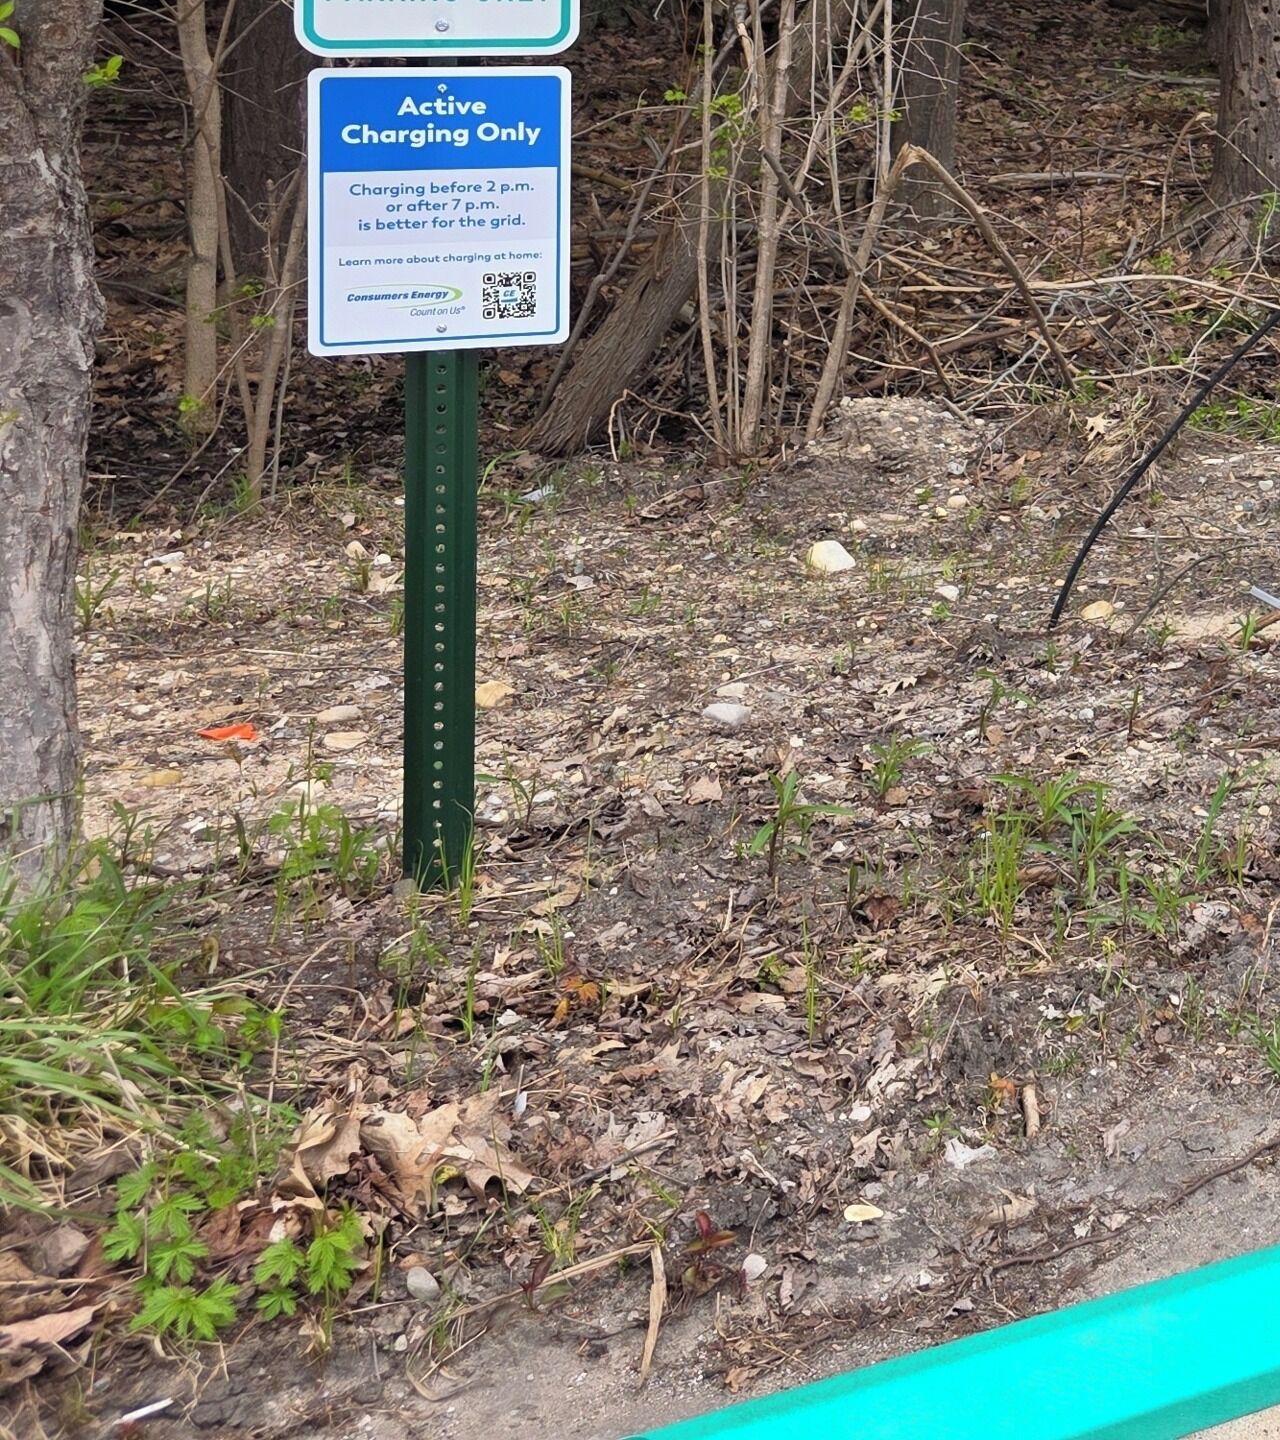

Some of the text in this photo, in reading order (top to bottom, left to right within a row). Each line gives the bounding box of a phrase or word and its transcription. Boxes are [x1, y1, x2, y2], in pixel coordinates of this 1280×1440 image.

[397, 95, 487, 116] Active
[341, 122, 541, 148] Charging Only
[349, 180, 534, 197] Charging before 2 p.m.
[386, 198, 499, 213] or after 7 p.m.
[358, 214, 526, 231] is better for the grid.
[338, 250, 543, 267] Learn more about charging at home:
[346, 289, 449, 303] Consumers Energy
[503, 289, 516, 298] CE
[410, 307, 436, 317] Count
[437, 307, 449, 316] on
